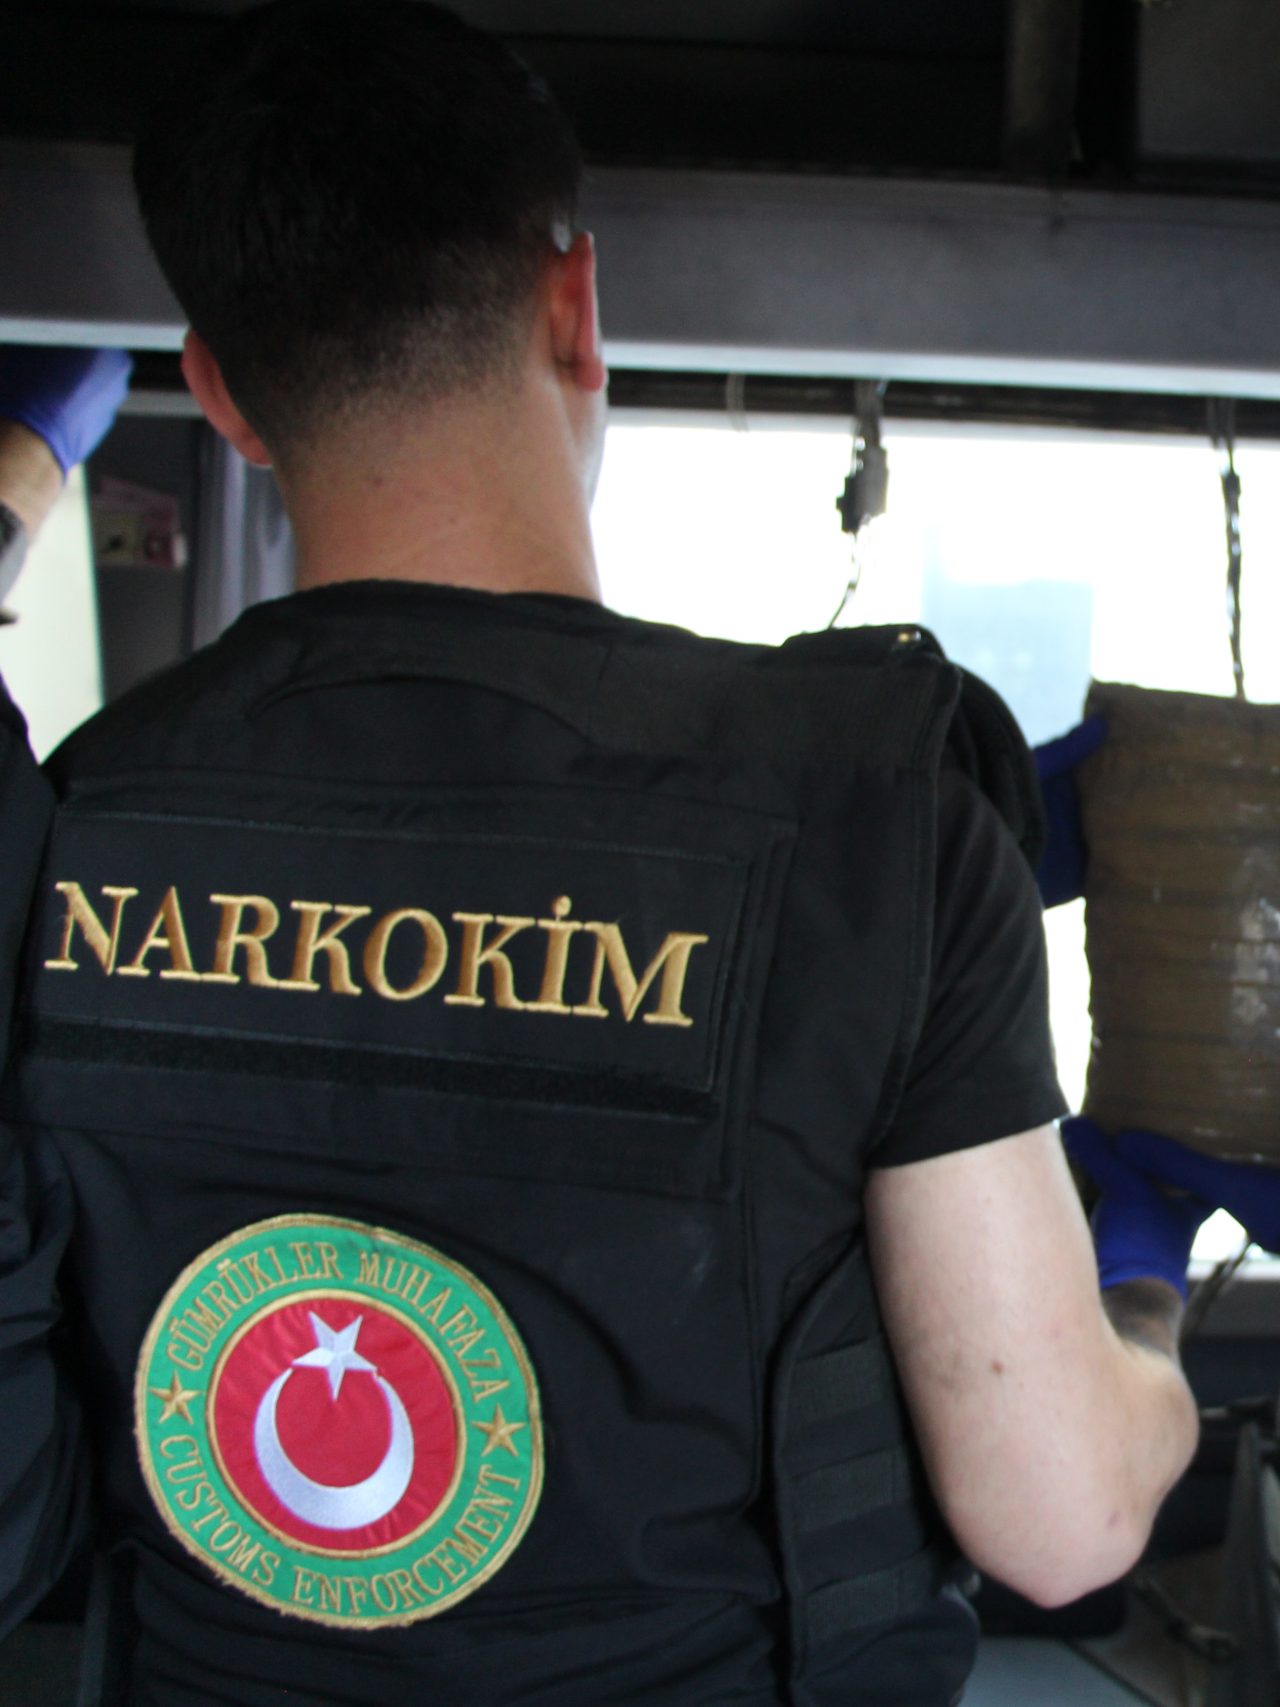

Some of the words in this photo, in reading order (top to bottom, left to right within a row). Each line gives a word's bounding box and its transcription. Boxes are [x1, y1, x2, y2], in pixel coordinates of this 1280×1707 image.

[44, 881, 709, 1027] NARKOKİM
[166, 1242, 344, 1371] GÜMRÜKLER
[354, 1251, 509, 1403] MUHAFAZA
[159, 1434, 281, 1587] CUSTOMS
[290, 1464, 521, 1615] ENFORCEMENT
